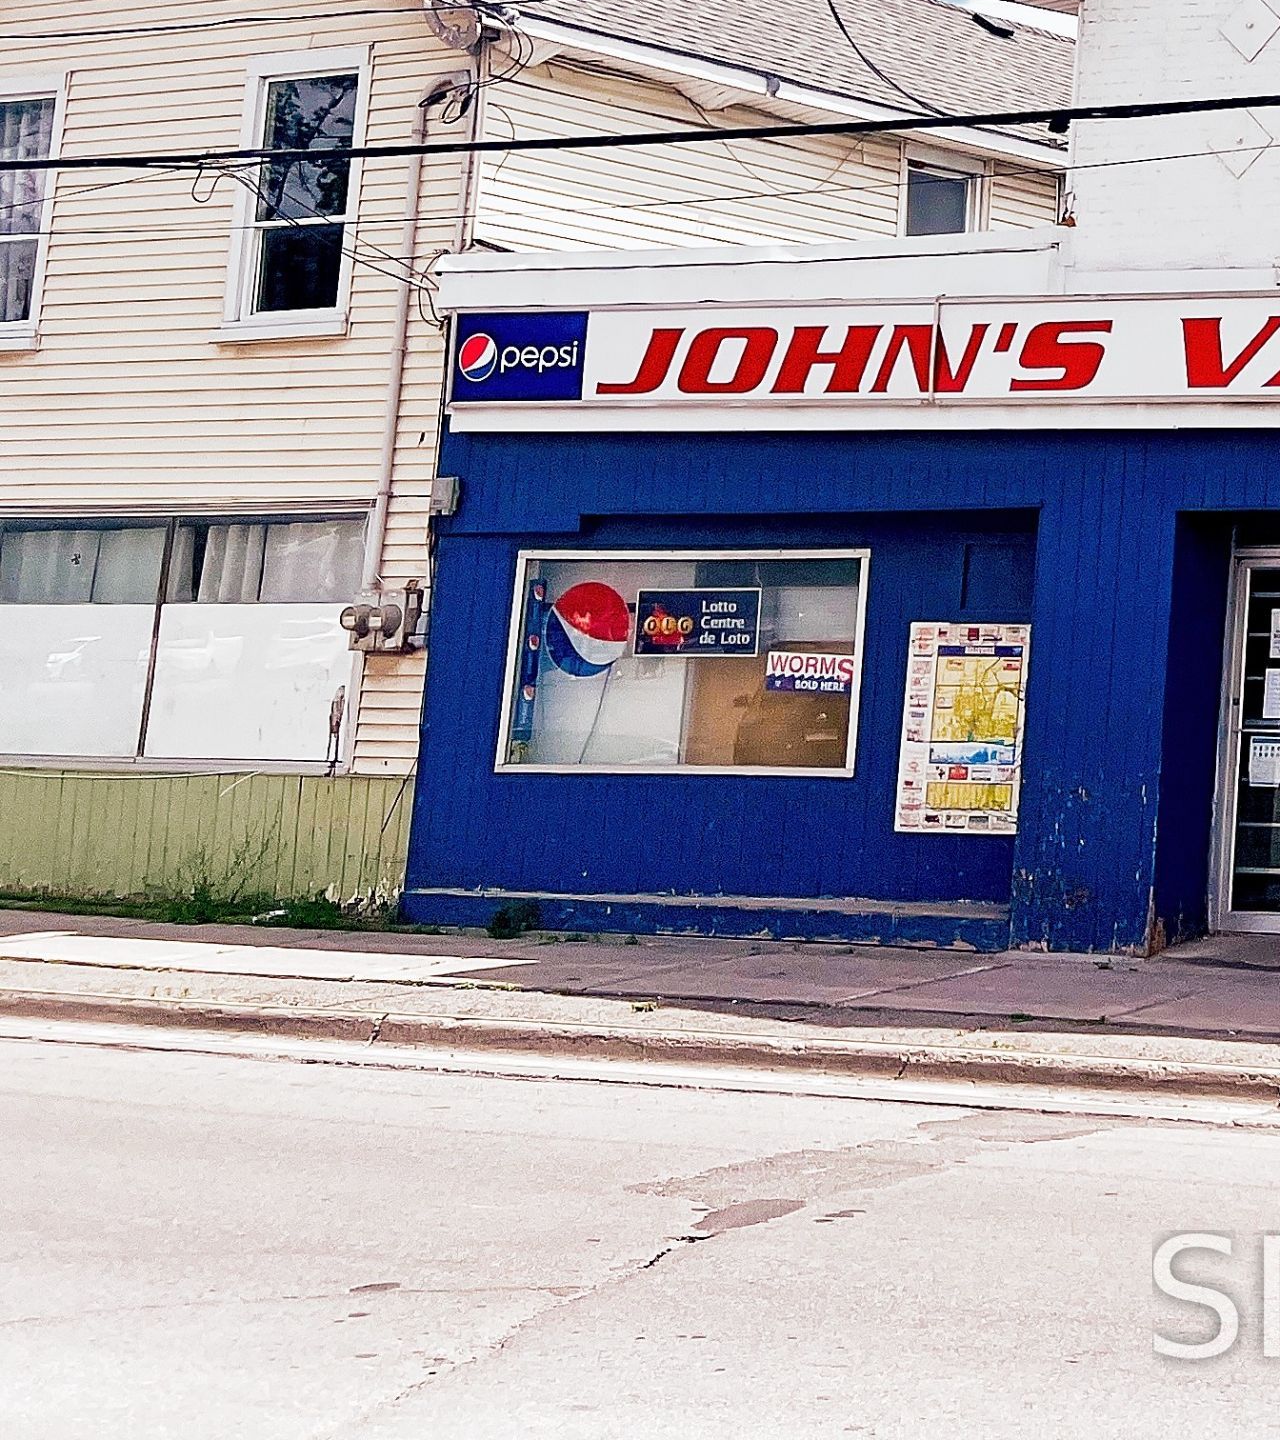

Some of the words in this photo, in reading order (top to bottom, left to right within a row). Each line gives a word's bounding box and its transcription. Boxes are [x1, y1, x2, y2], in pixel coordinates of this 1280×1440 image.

[500, 340, 578, 374] pepsi
[596, 320, 1113, 395] JOHN'S
[702, 600, 737, 613] Lotto
[645, 616, 692, 634] OLG
[700, 615, 745, 629] Centre
[699, 631, 716, 645] de
[720, 632, 751, 645] Loto
[771, 655, 854, 684] WORMS
[794, 679, 819, 690] SOLD
[820, 681, 845, 692] HERE
